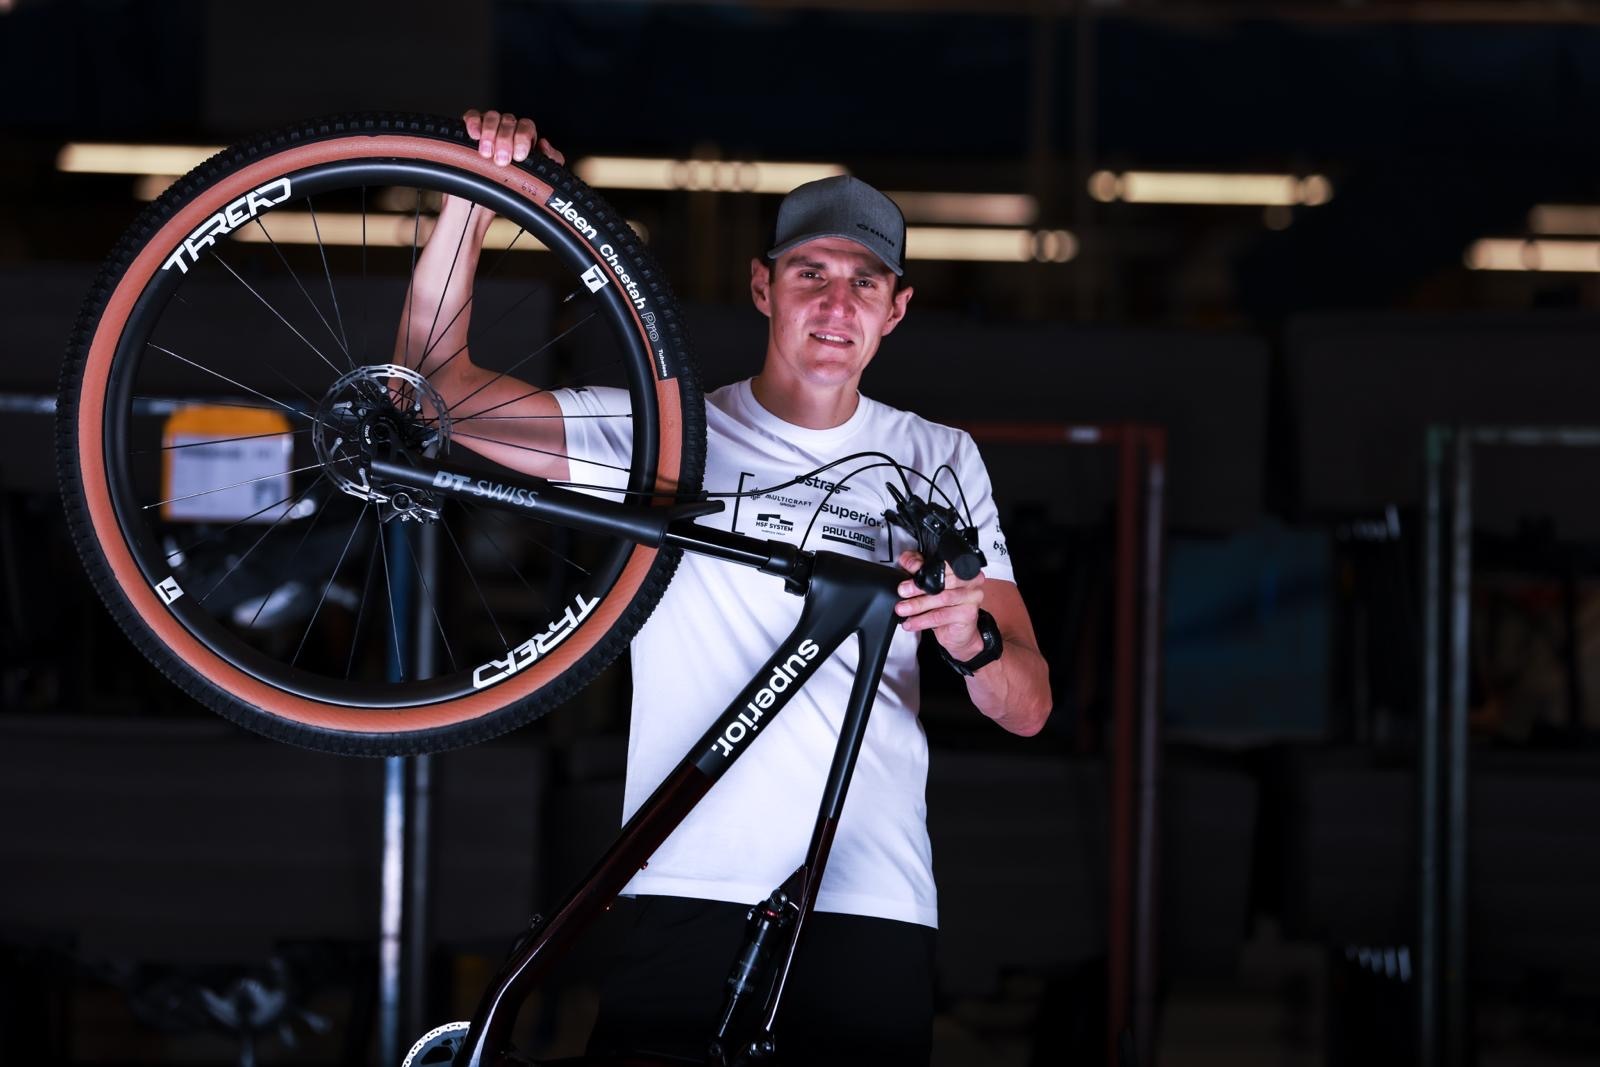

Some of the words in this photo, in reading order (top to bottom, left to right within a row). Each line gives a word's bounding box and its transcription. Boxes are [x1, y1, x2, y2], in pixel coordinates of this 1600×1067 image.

[549, 197, 598, 240] zleen
[599, 244, 646, 310] Cheetah
[641, 311, 660, 343] Pro
[432, 470, 471, 491] DT
[473, 480, 539, 508] SWISS
[765, 494, 812, 507] MULTICRAFT
[769, 523, 793, 532] SYSTEM
[822, 525, 848, 538] PAUL
[848, 530, 876, 547] LANGE
